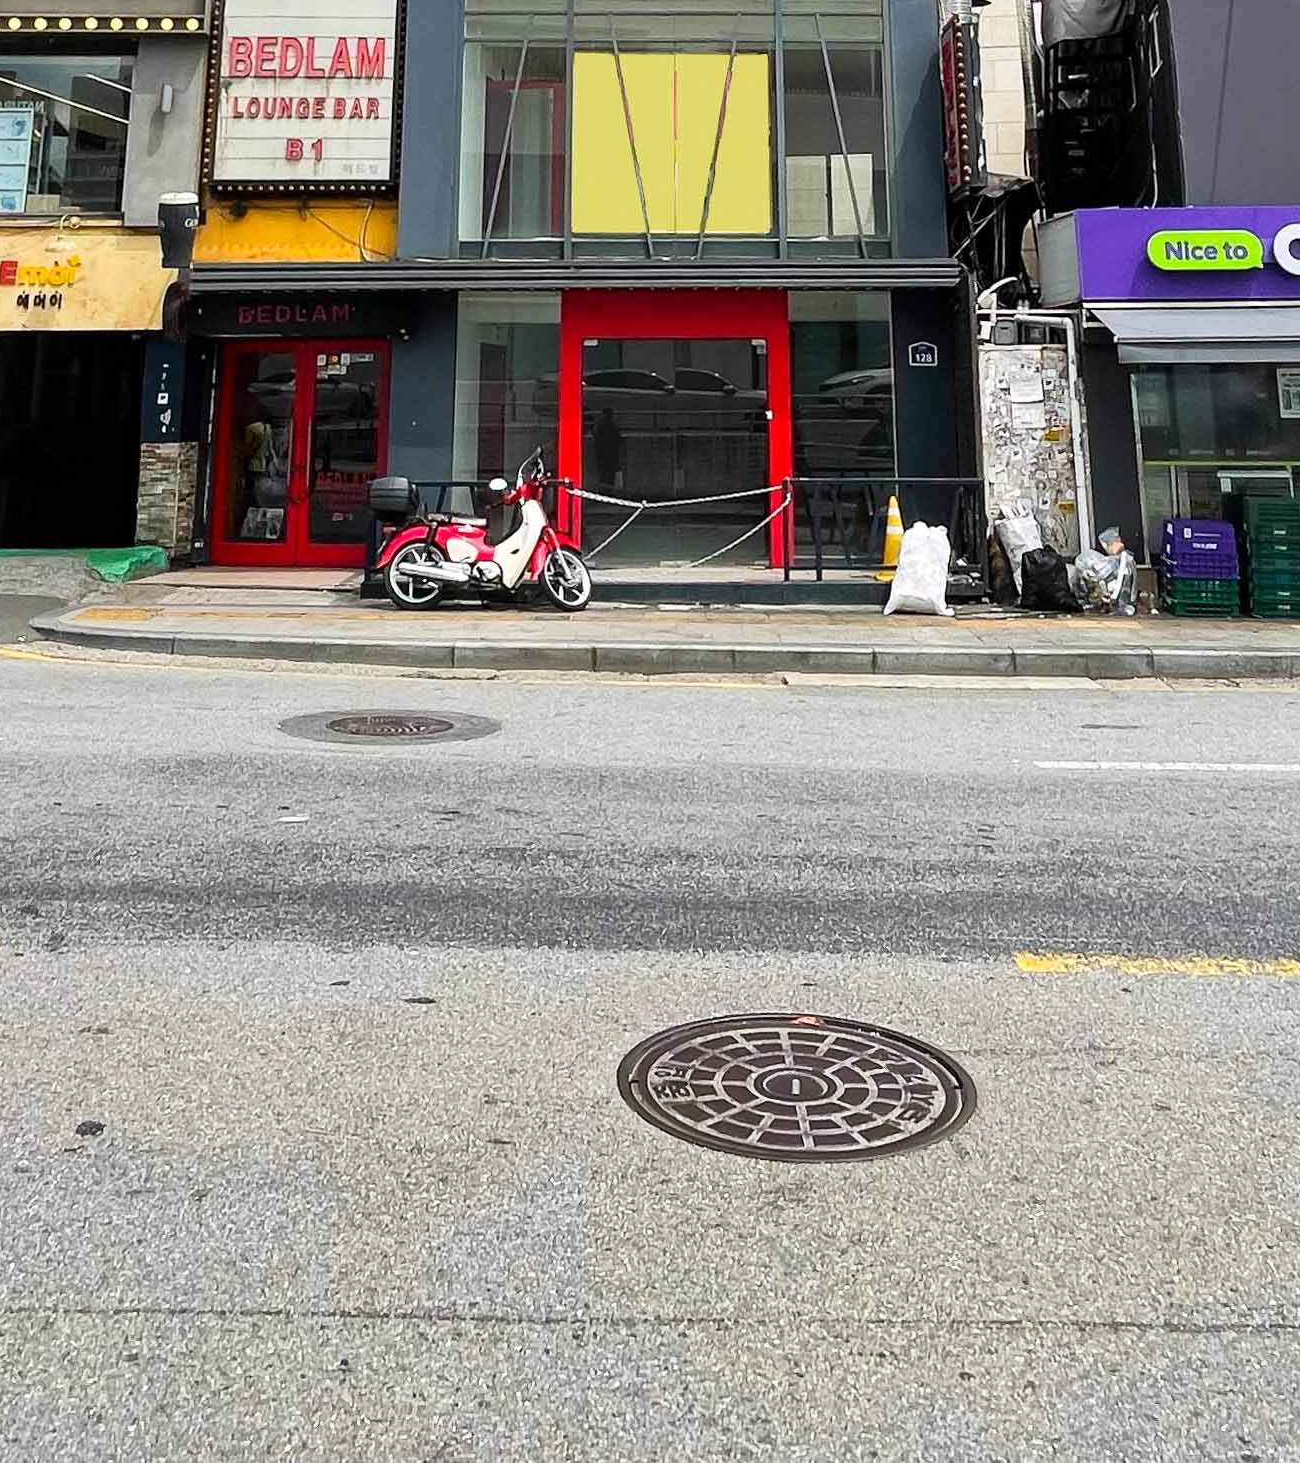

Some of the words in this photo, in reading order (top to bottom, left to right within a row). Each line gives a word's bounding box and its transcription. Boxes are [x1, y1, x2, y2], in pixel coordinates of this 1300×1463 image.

[229, 36, 387, 80] BEDLAM
[232, 96, 327, 120] LOUNGE
[332, 97, 380, 120] BAR
[1163, 241, 1218, 261] Nice
[1222, 240, 1249, 261] to
[237, 304, 350, 324] BEDLAM
[915, 353, 933, 363] 128
